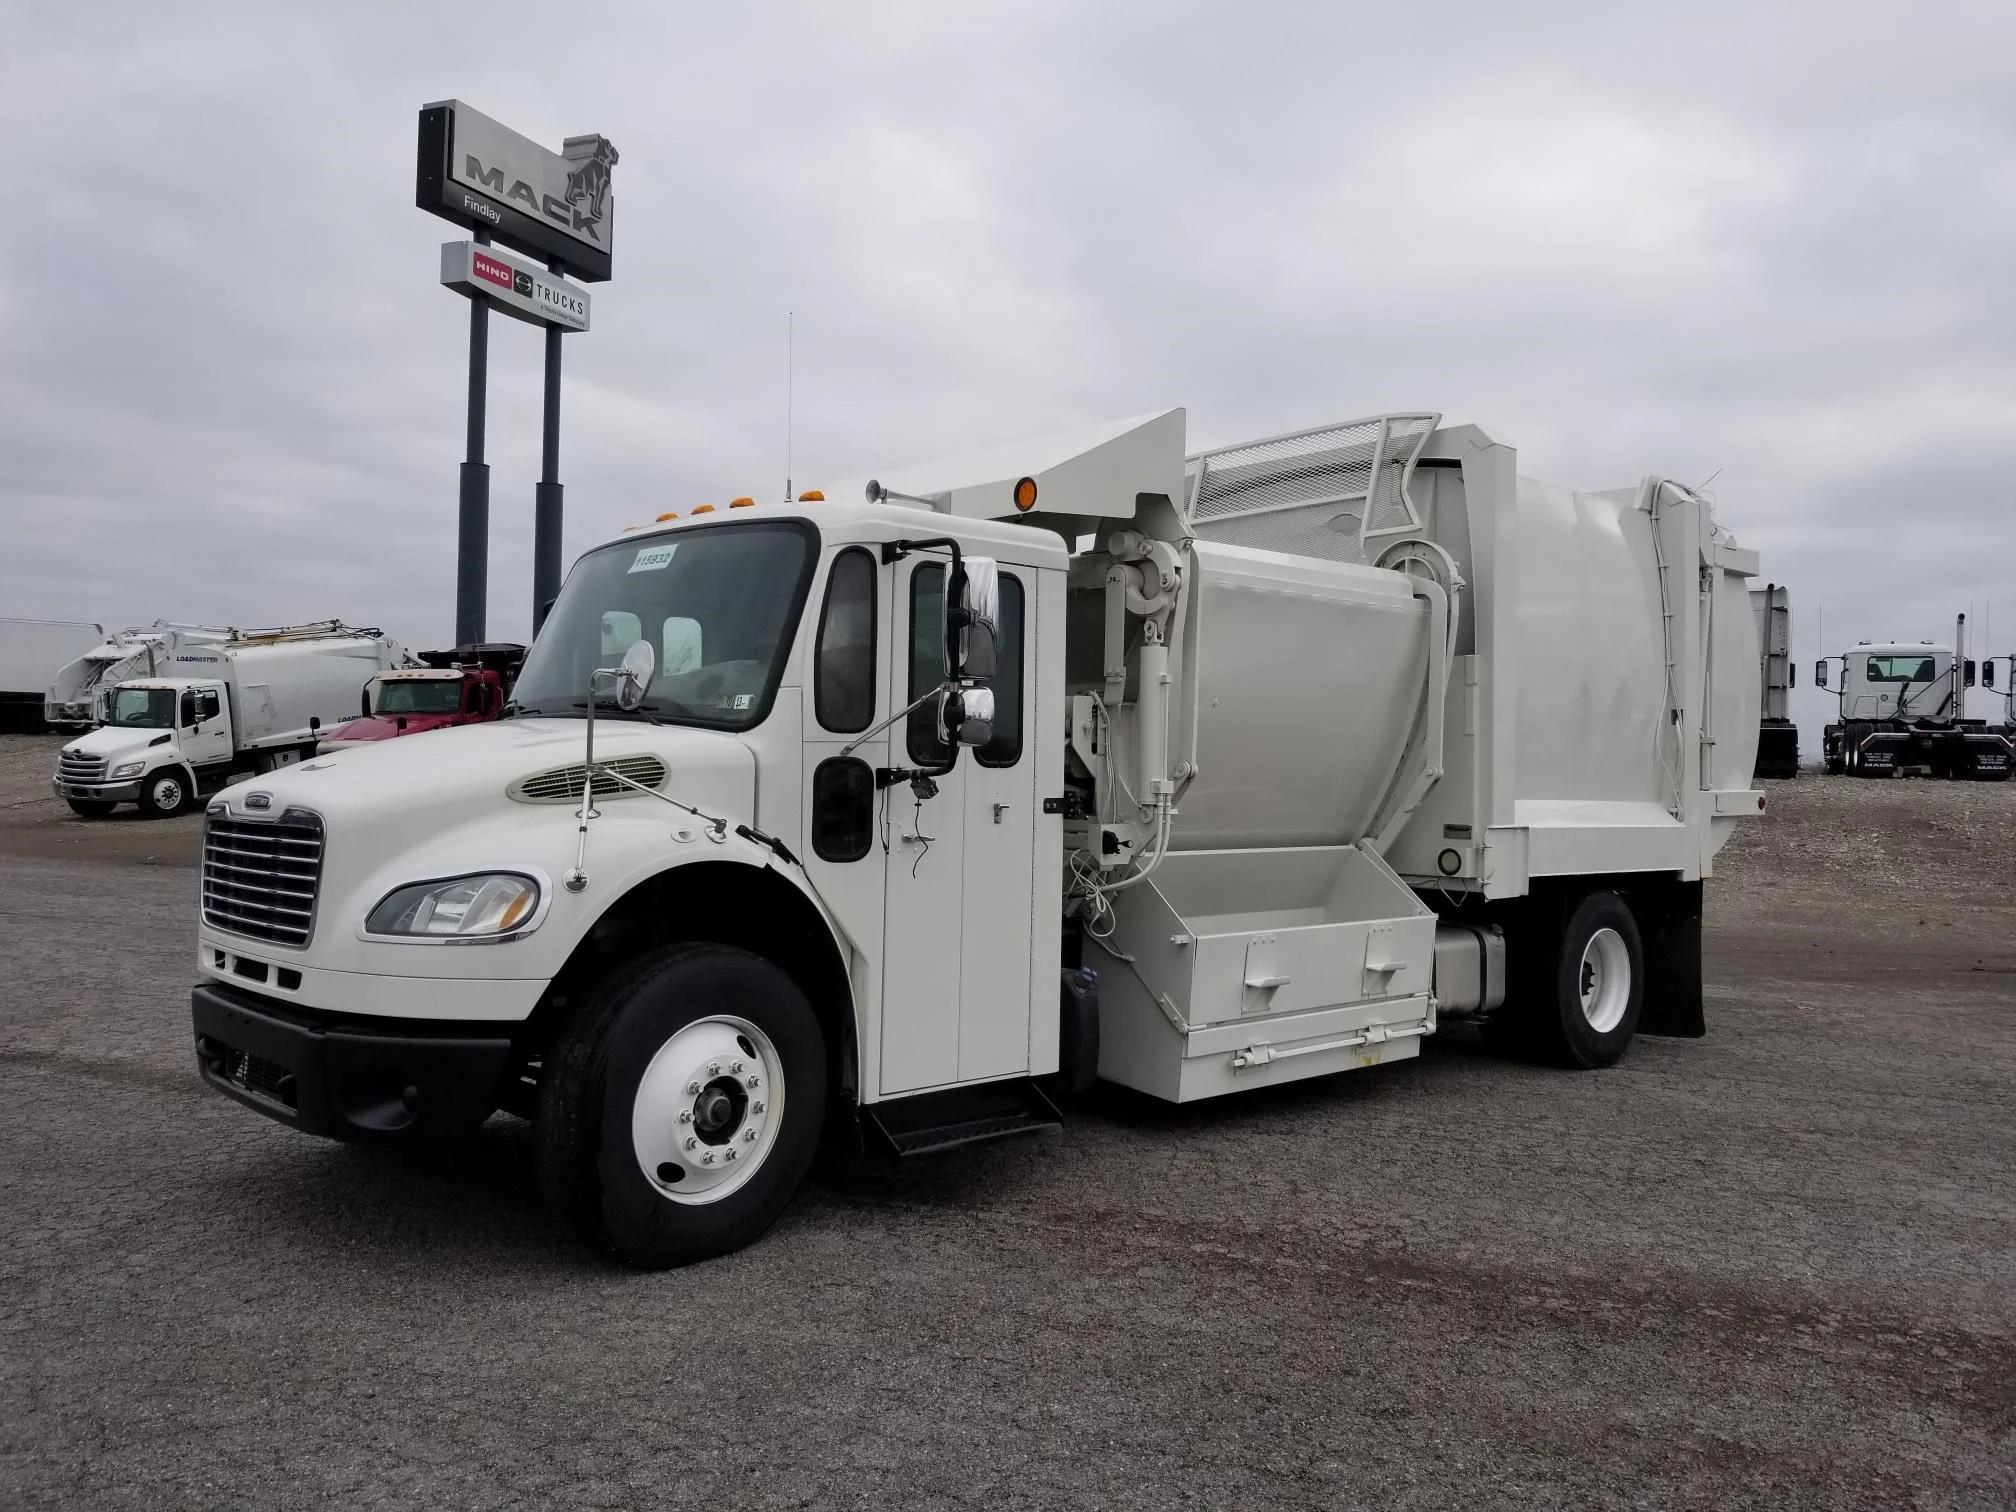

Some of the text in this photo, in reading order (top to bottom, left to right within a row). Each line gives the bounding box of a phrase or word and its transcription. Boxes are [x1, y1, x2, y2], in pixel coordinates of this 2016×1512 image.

[464, 194, 501, 224] Findlay
[466, 153, 602, 242] MACK
[476, 260, 583, 315] HINO TRUCKS
[635, 552, 671, 567] 115932
[176, 655, 218, 664] LOADMASTER
